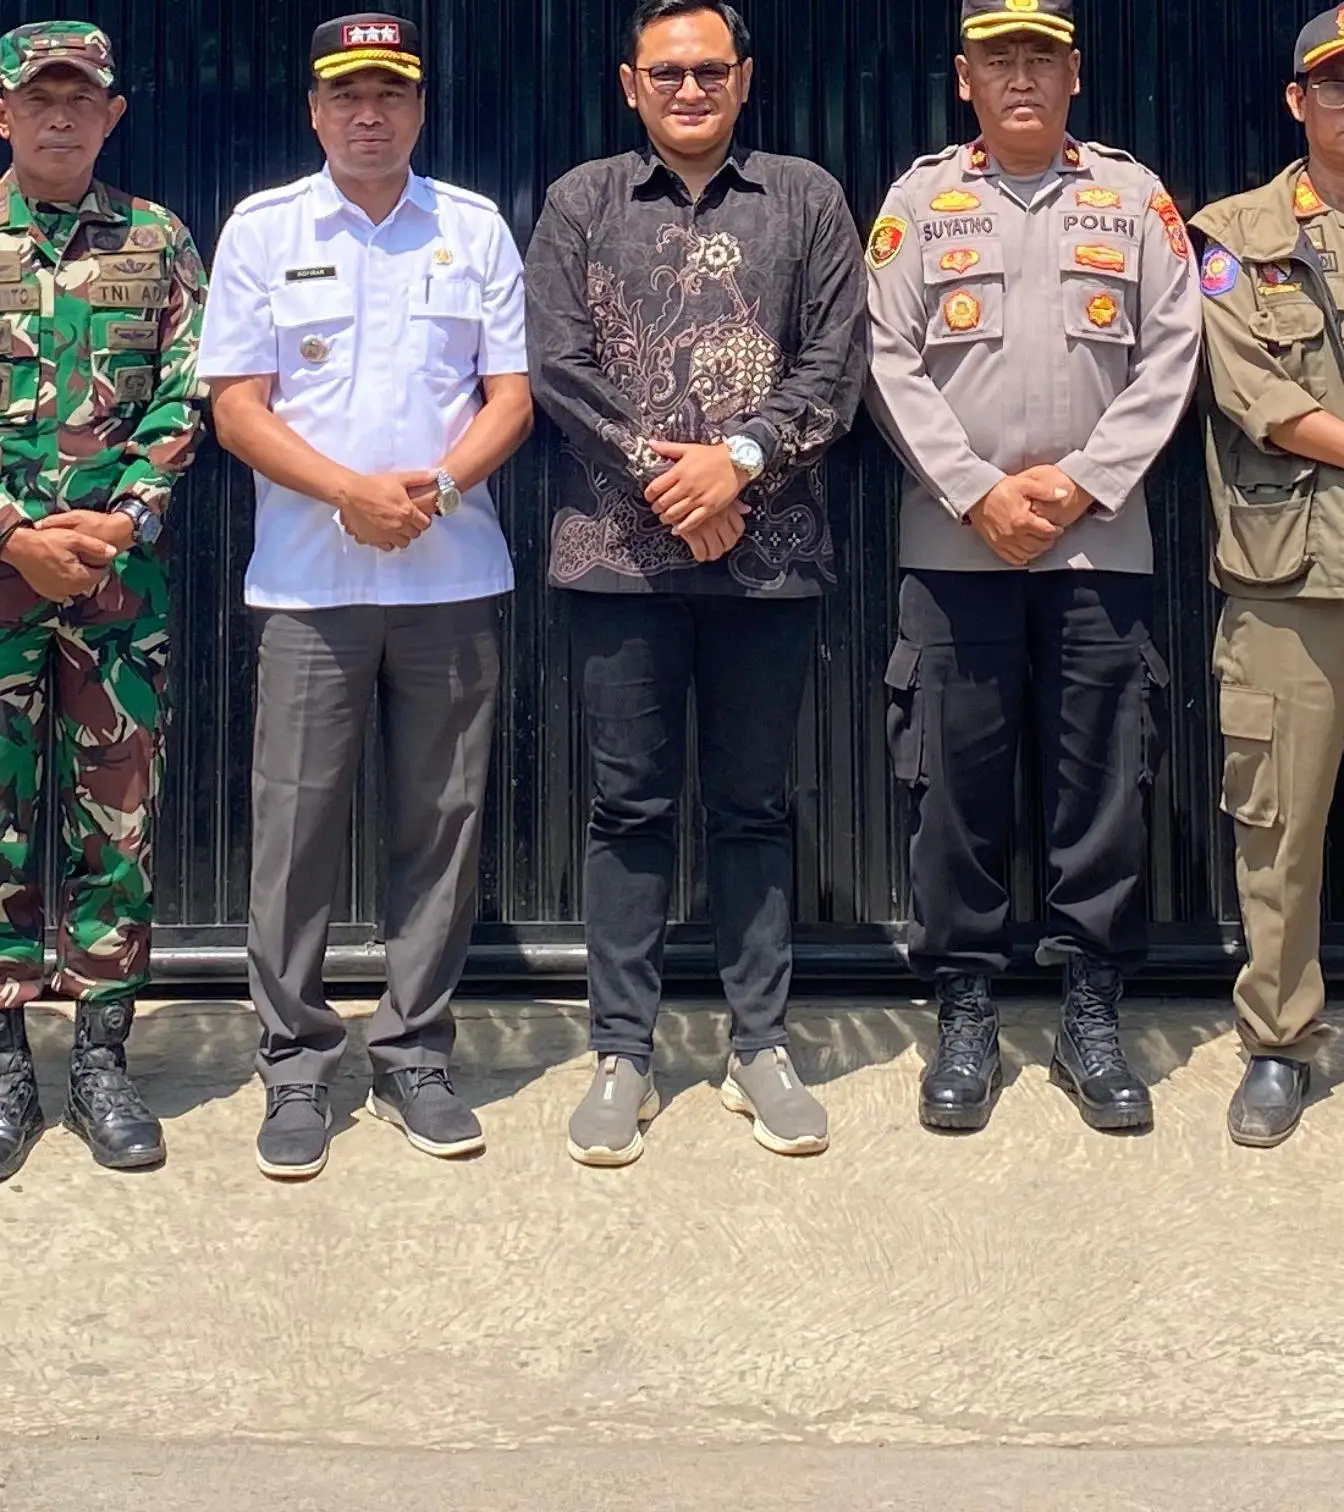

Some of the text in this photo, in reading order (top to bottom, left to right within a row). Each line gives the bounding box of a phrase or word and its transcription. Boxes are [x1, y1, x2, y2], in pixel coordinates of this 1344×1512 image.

[922, 217, 994, 242] SUYATNO
[1063, 214, 1136, 239] POLRI
[98, 285, 162, 303] TNI AD
